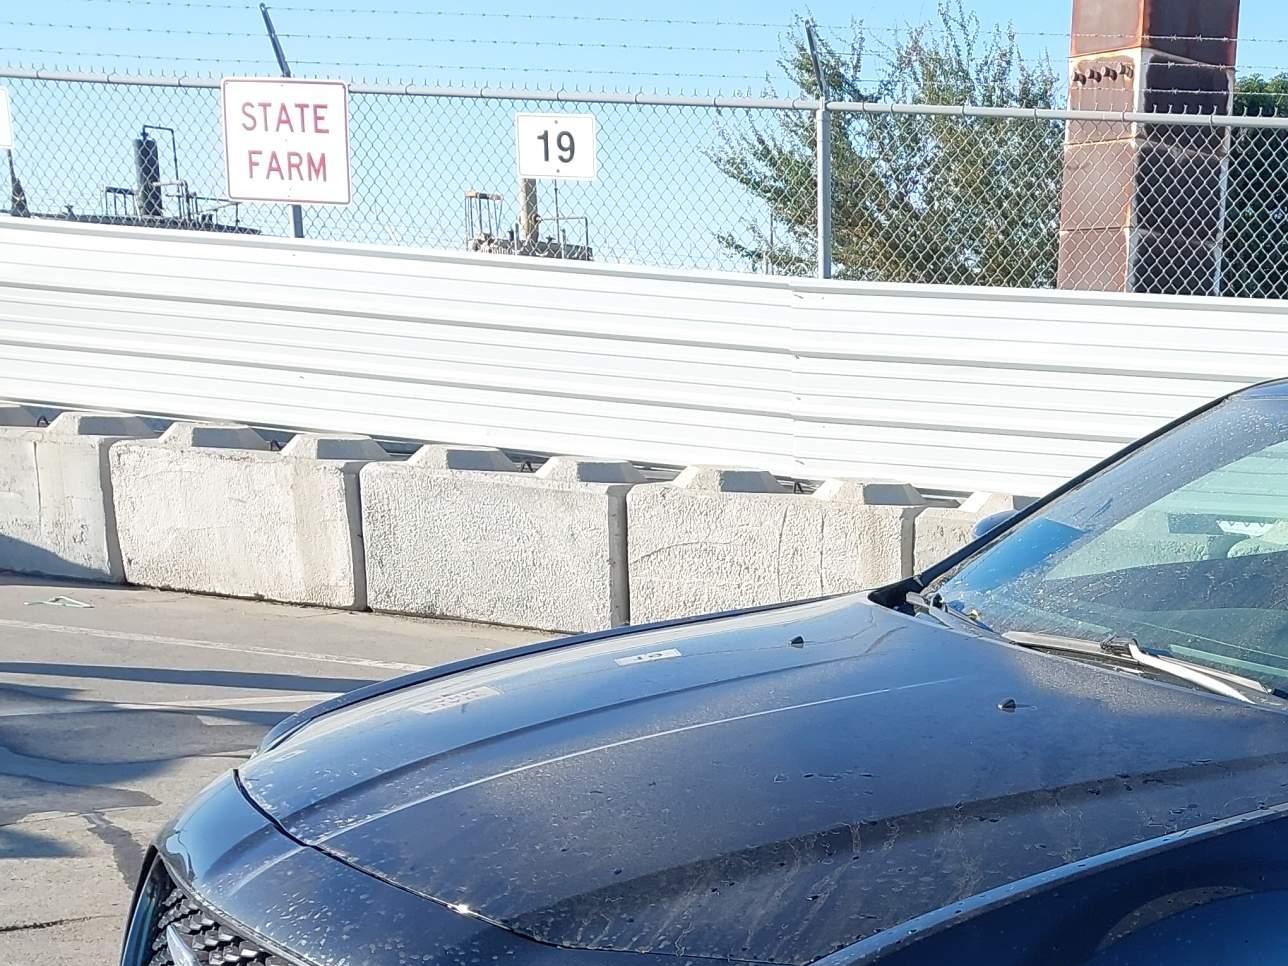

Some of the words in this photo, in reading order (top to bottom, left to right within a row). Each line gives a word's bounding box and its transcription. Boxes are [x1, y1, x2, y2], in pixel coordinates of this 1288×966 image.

[241, 101, 330, 134] STATE
[536, 129, 576, 164] 19
[247, 149, 328, 183] FARM
